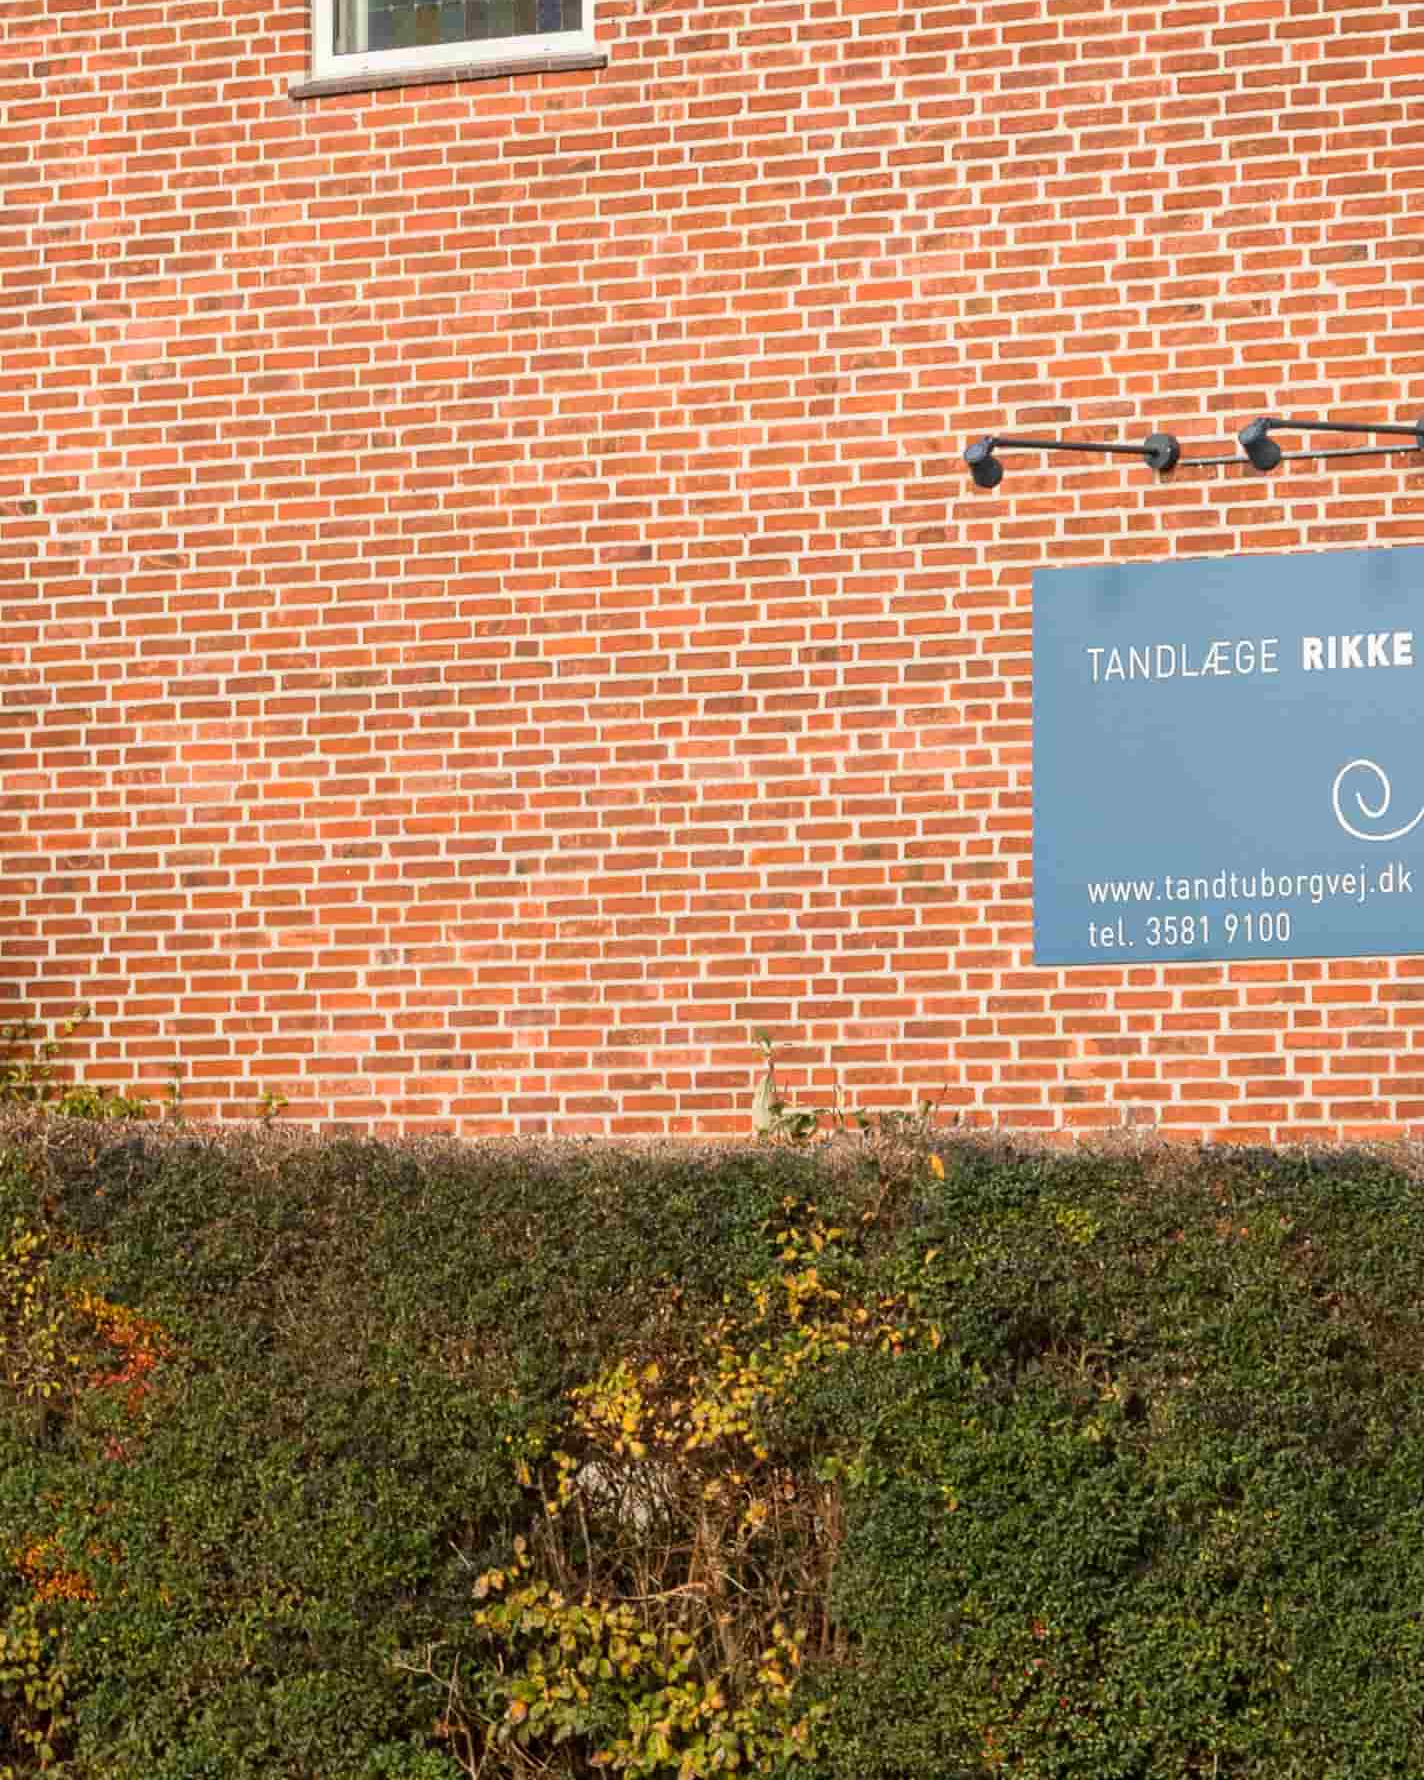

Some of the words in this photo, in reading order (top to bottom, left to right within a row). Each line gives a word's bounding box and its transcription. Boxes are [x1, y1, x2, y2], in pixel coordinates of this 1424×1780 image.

[1087, 638, 1279, 682] TANDLÆGE
[1302, 632, 1413, 671] RIKKE
[1087, 863, 1414, 904] www.tandtuborgvej.dk
[1088, 917, 1134, 948] tel.
[1145, 915, 1209, 946] 3581
[1224, 911, 1290, 944] 9100
